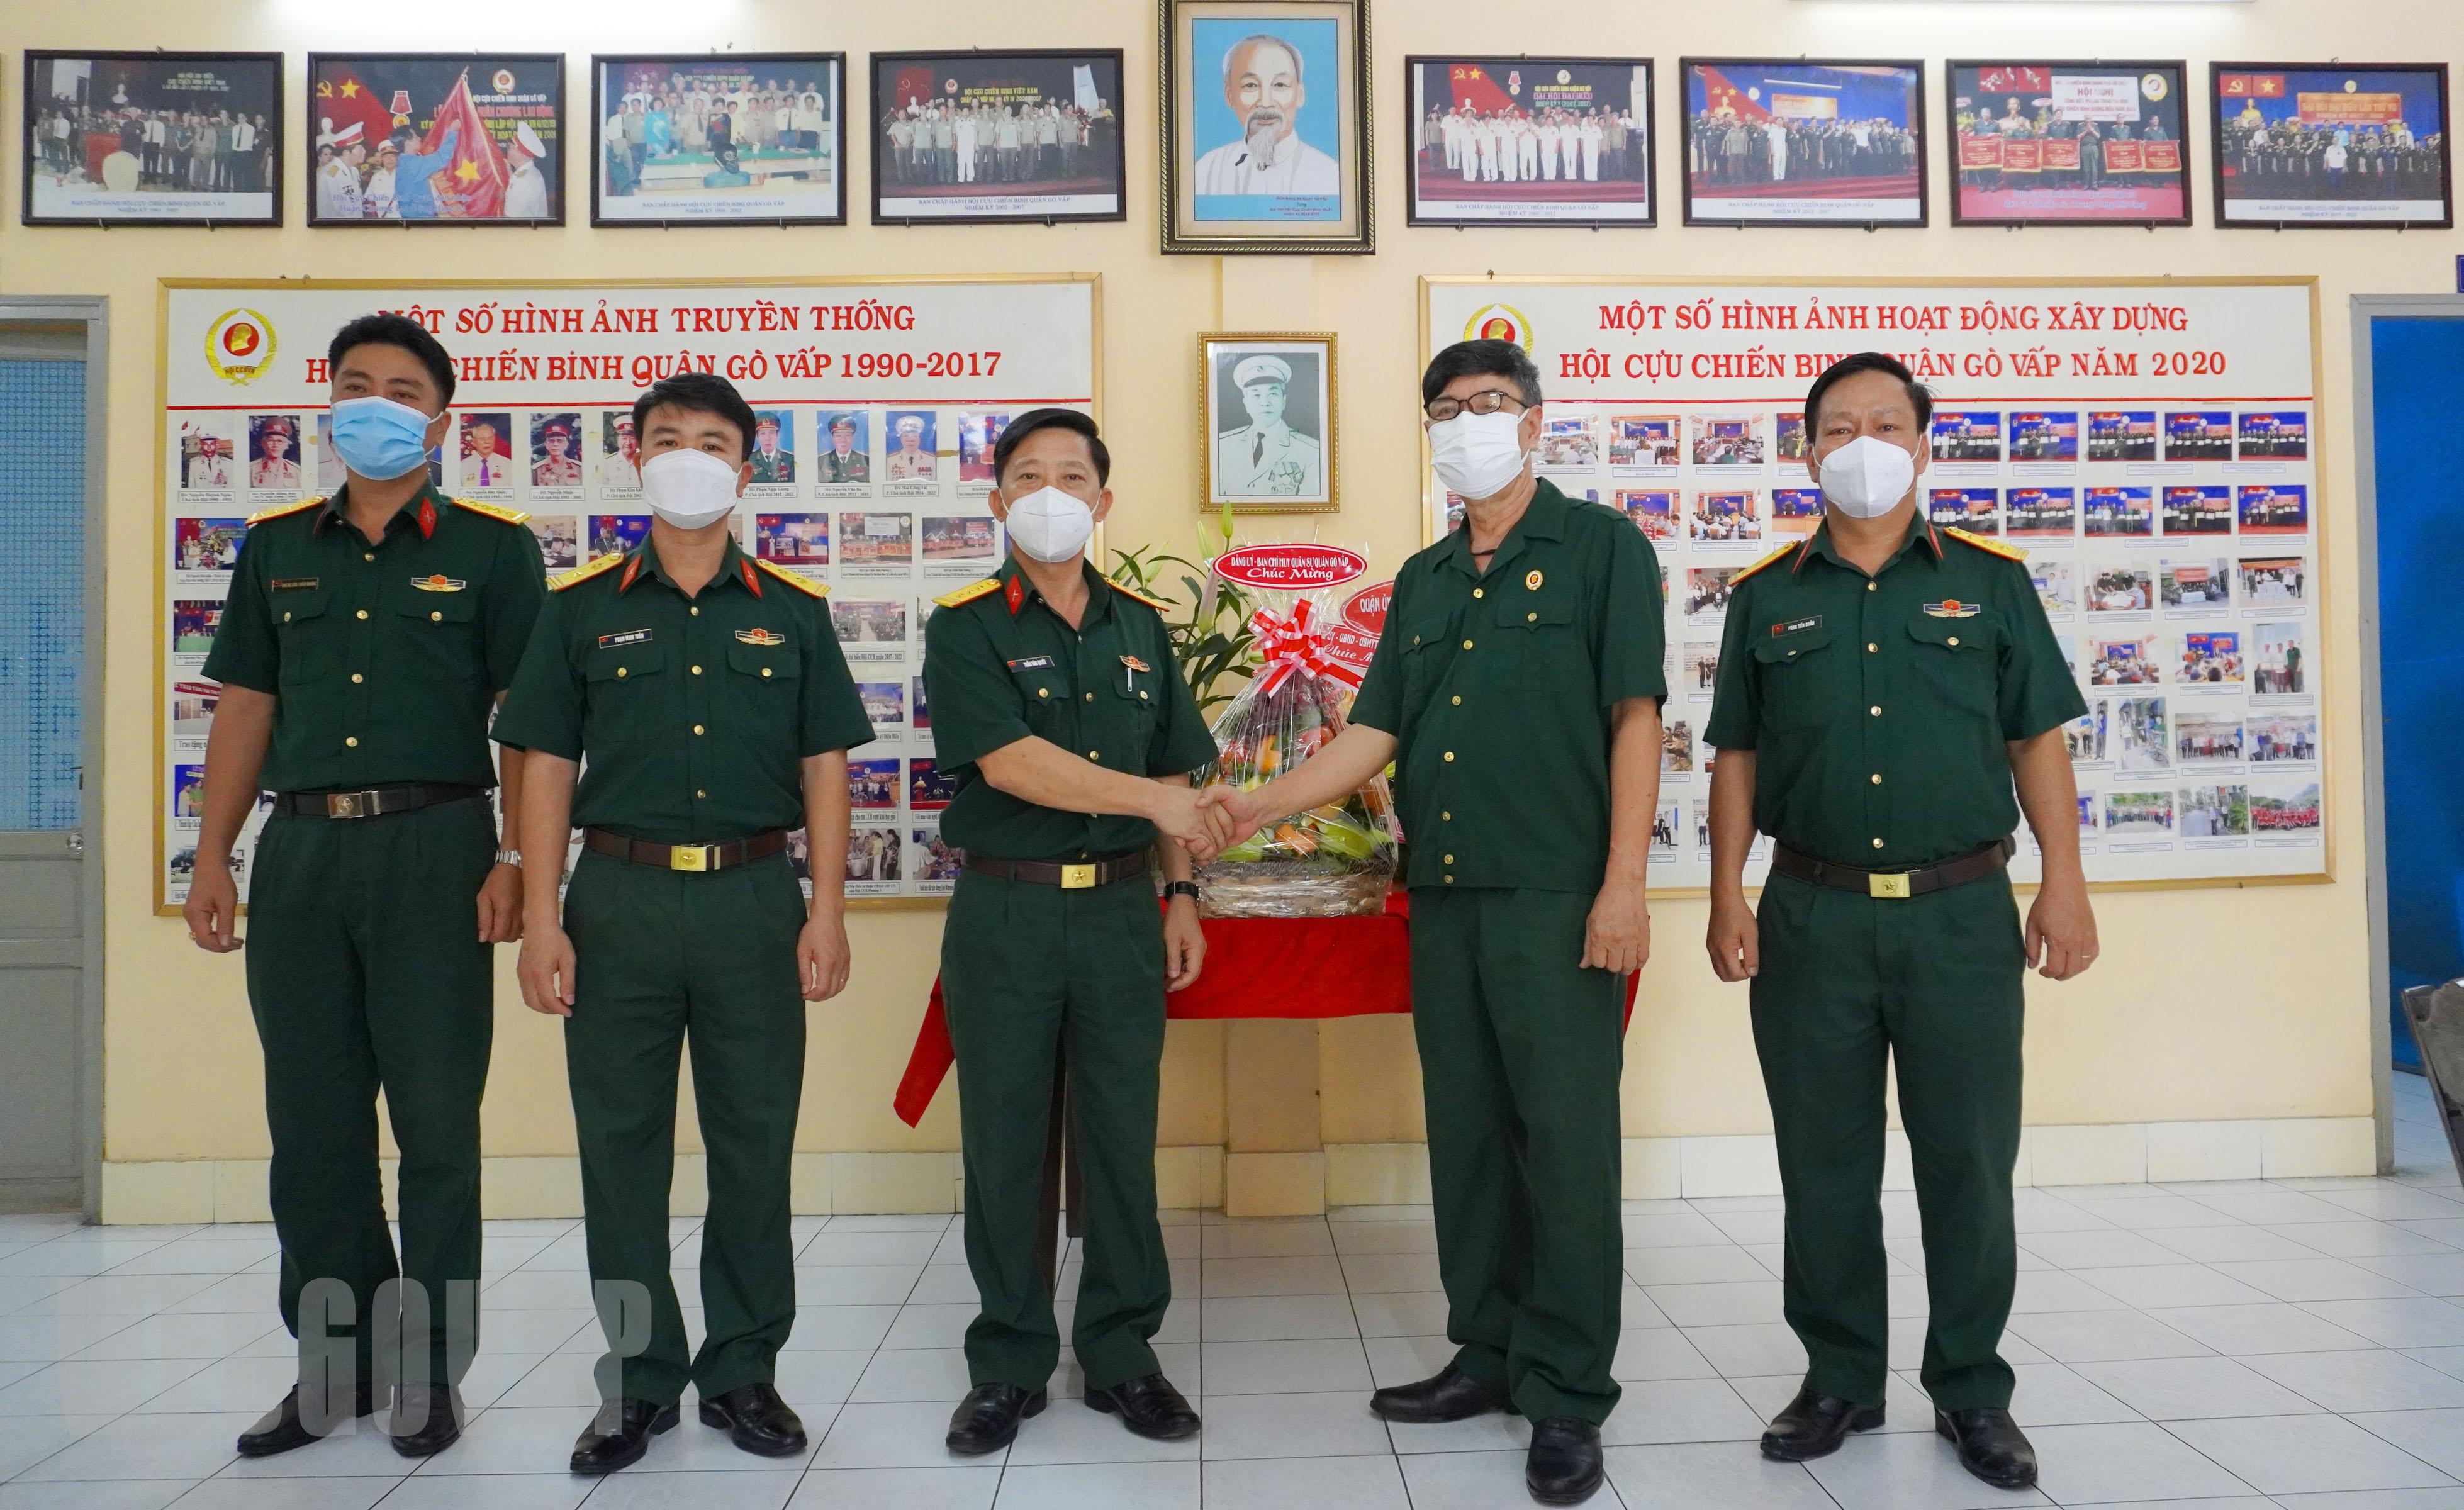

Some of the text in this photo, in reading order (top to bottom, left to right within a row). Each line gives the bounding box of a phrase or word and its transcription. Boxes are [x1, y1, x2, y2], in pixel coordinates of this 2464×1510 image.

[456, 302, 498, 333] SỐ
[501, 302, 584, 333] HÌNH
[590, 299, 659, 333] ẢNH
[671, 299, 800, 332] TRUYỀN
[810, 299, 916, 330] THỐNG
[1599, 296, 2188, 337] MỘT SỐ HÌNH ẢNH HOẠT ĐỘNG XÂY DỰNG
[727, 349, 768, 380] GÒ
[775, 346, 832, 379] VẤP
[841, 351, 1002, 378] 1990-2017
[1560, 347, 1611, 384] HỘI
[1624, 350, 1683, 384] CỰU
[1691, 344, 1786, 378] CHIẾN
[1964, 347, 2003, 378] GÒ
[2009, 345, 2062, 378] VẤP
[2071, 346, 2139, 376] NĂM
[2152, 350, 2226, 376] 2020
[1246, 568, 1333, 581] Chúc Mừng
[1257, 557, 1268, 566] BAN
[1279, 558, 1290, 567] HUY
[1360, 595, 1380, 617] QUẬN
[1339, 633, 1355, 645] UBND
